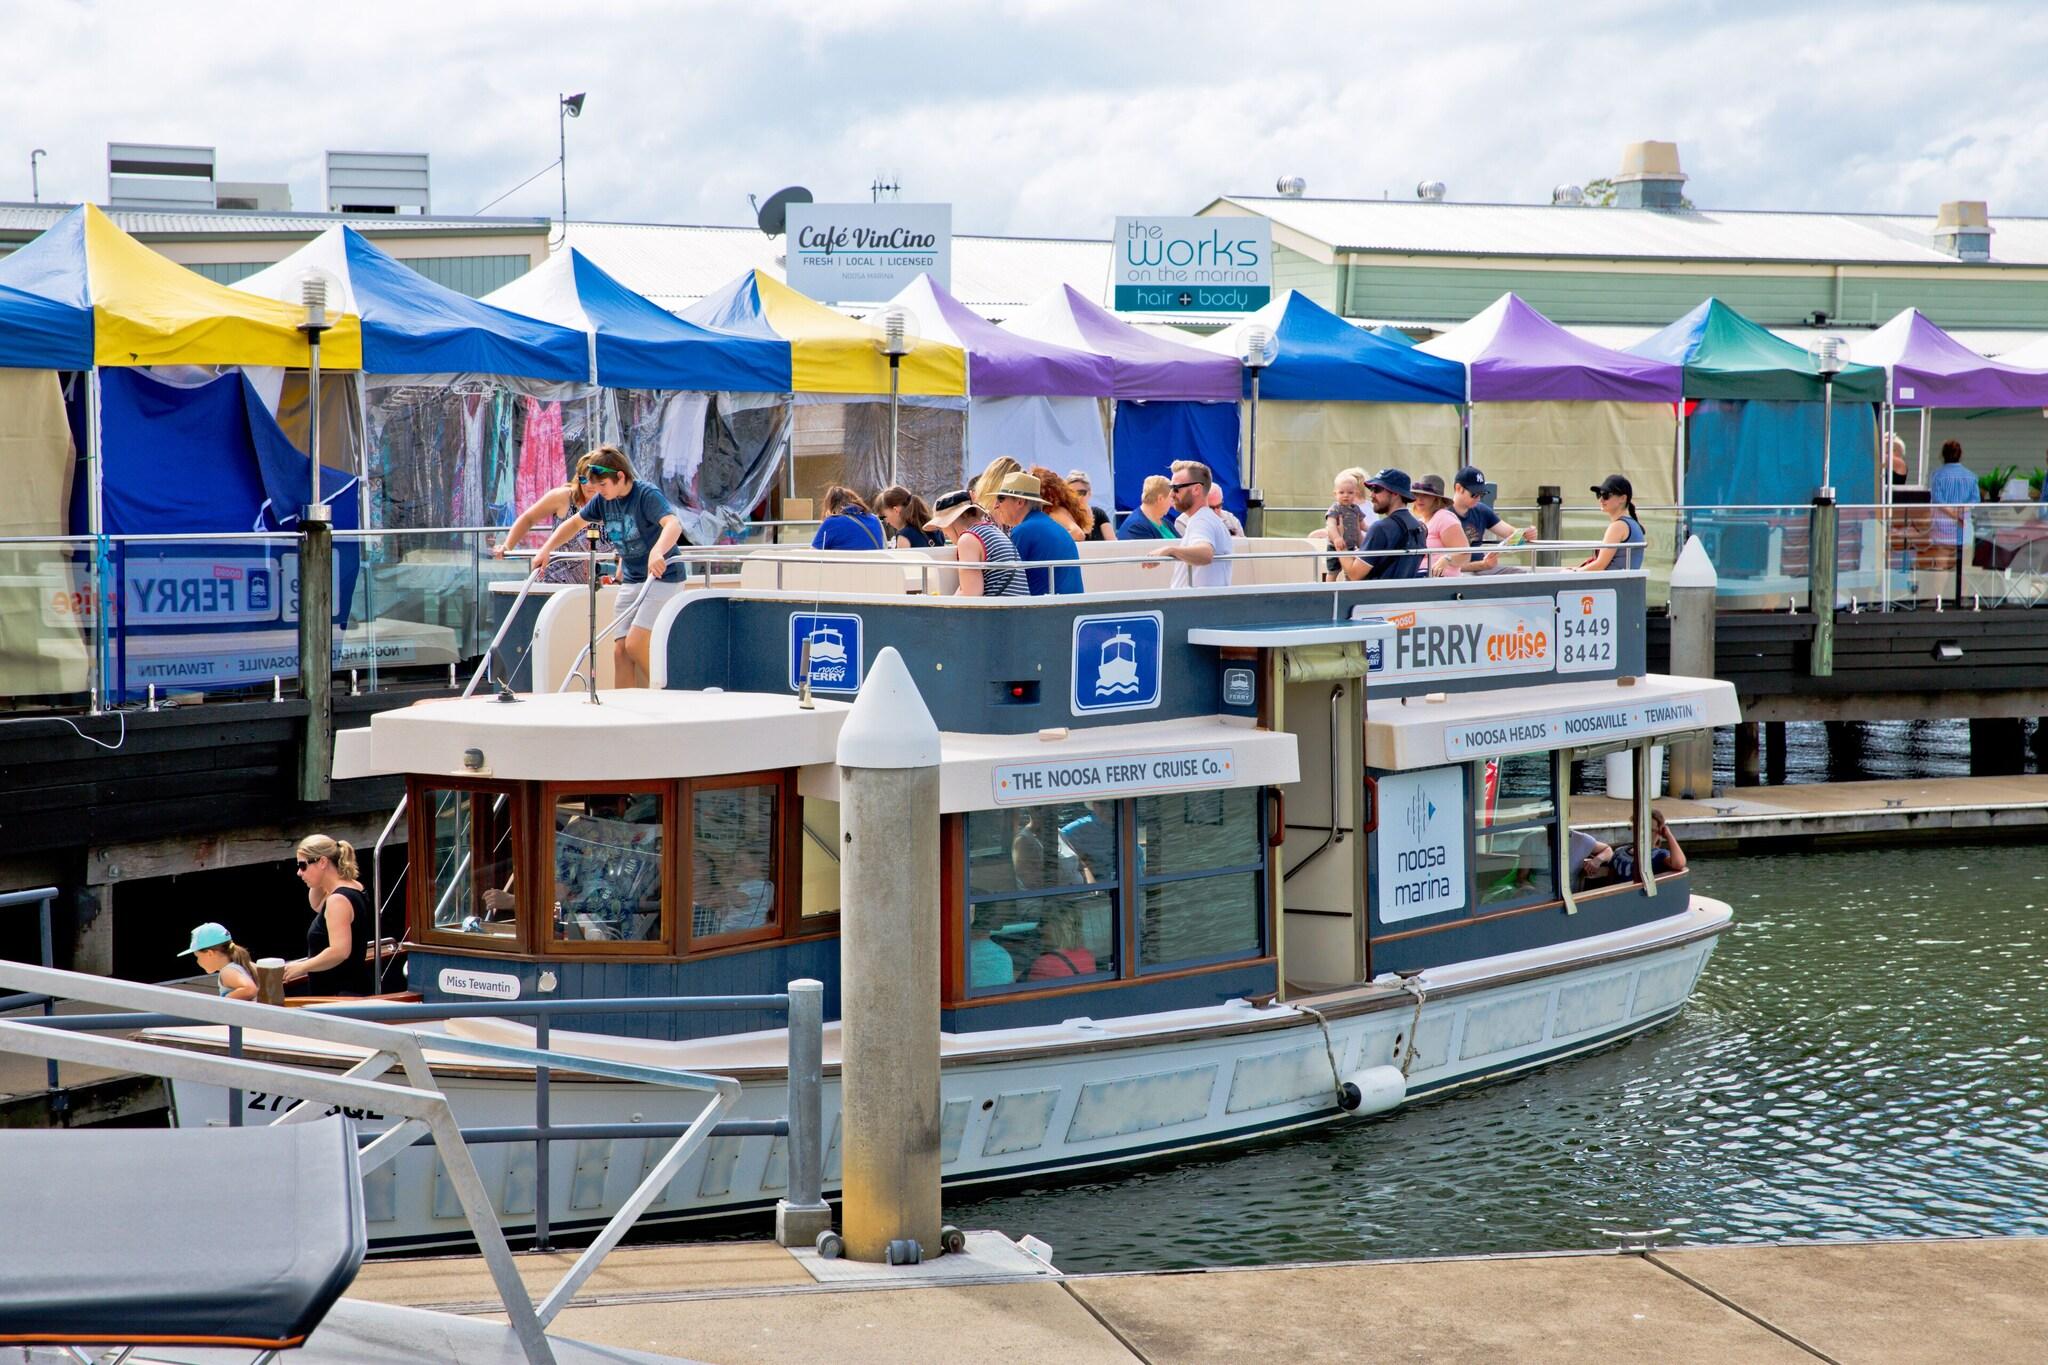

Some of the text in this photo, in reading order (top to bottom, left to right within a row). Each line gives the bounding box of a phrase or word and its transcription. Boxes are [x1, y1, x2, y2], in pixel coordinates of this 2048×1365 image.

[799, 225, 936, 255] Café VinCino
[1128, 220, 1163, 239] the
[1128, 228, 1258, 266] works
[803, 257, 933, 266] FRESH LOCAL LICENSED
[842, 272, 894, 280] NOOSA MARINA
[1128, 266, 1258, 282] on the marina
[1137, 288, 1174, 305] hair
[1199, 288, 1248, 310] body
[1564, 617, 1610, 639] 5449
[1396, 622, 1547, 670] FERRY cruise
[1564, 642, 1610, 663] 8442
[1465, 703, 1693, 748] NOOSA HEADS NOOSAVILLE TEWANTIN
[1012, 758, 1222, 790] THE NOOSA FERRY CRUISE Co.
[1398, 845, 1446, 873] noosa
[1395, 872, 1450, 907] marina
[446, 975, 511, 993] Miss Tewantin
